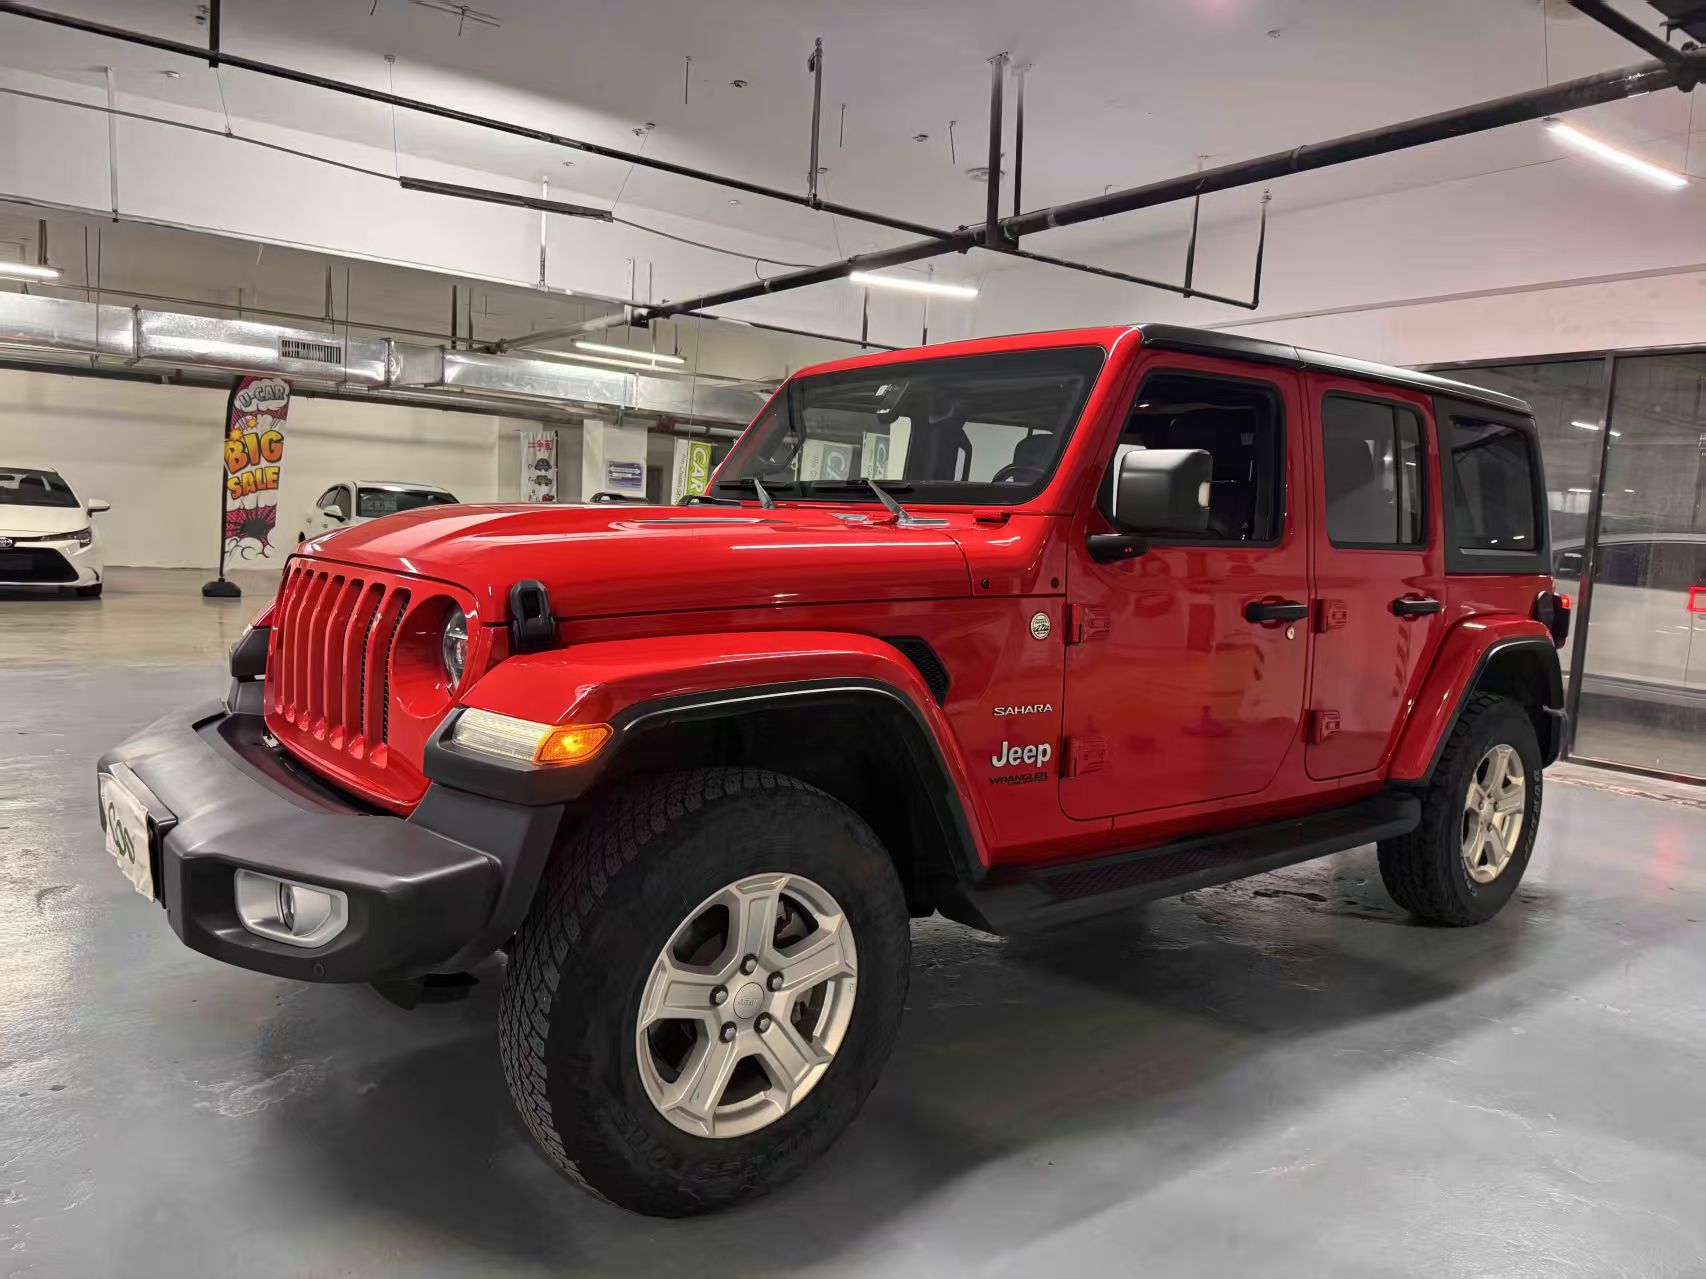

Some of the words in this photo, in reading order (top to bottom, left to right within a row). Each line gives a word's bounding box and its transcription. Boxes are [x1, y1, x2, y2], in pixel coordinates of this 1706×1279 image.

[239, 384, 286, 408] U-CAR
[224, 429, 285, 474] BIG
[690, 446, 707, 493] CAR
[227, 466, 281, 501] SALE
[993, 703, 1053, 717] SAHARA
[991, 741, 1052, 768] Jeep
[988, 771, 1049, 785] WRANGLER
